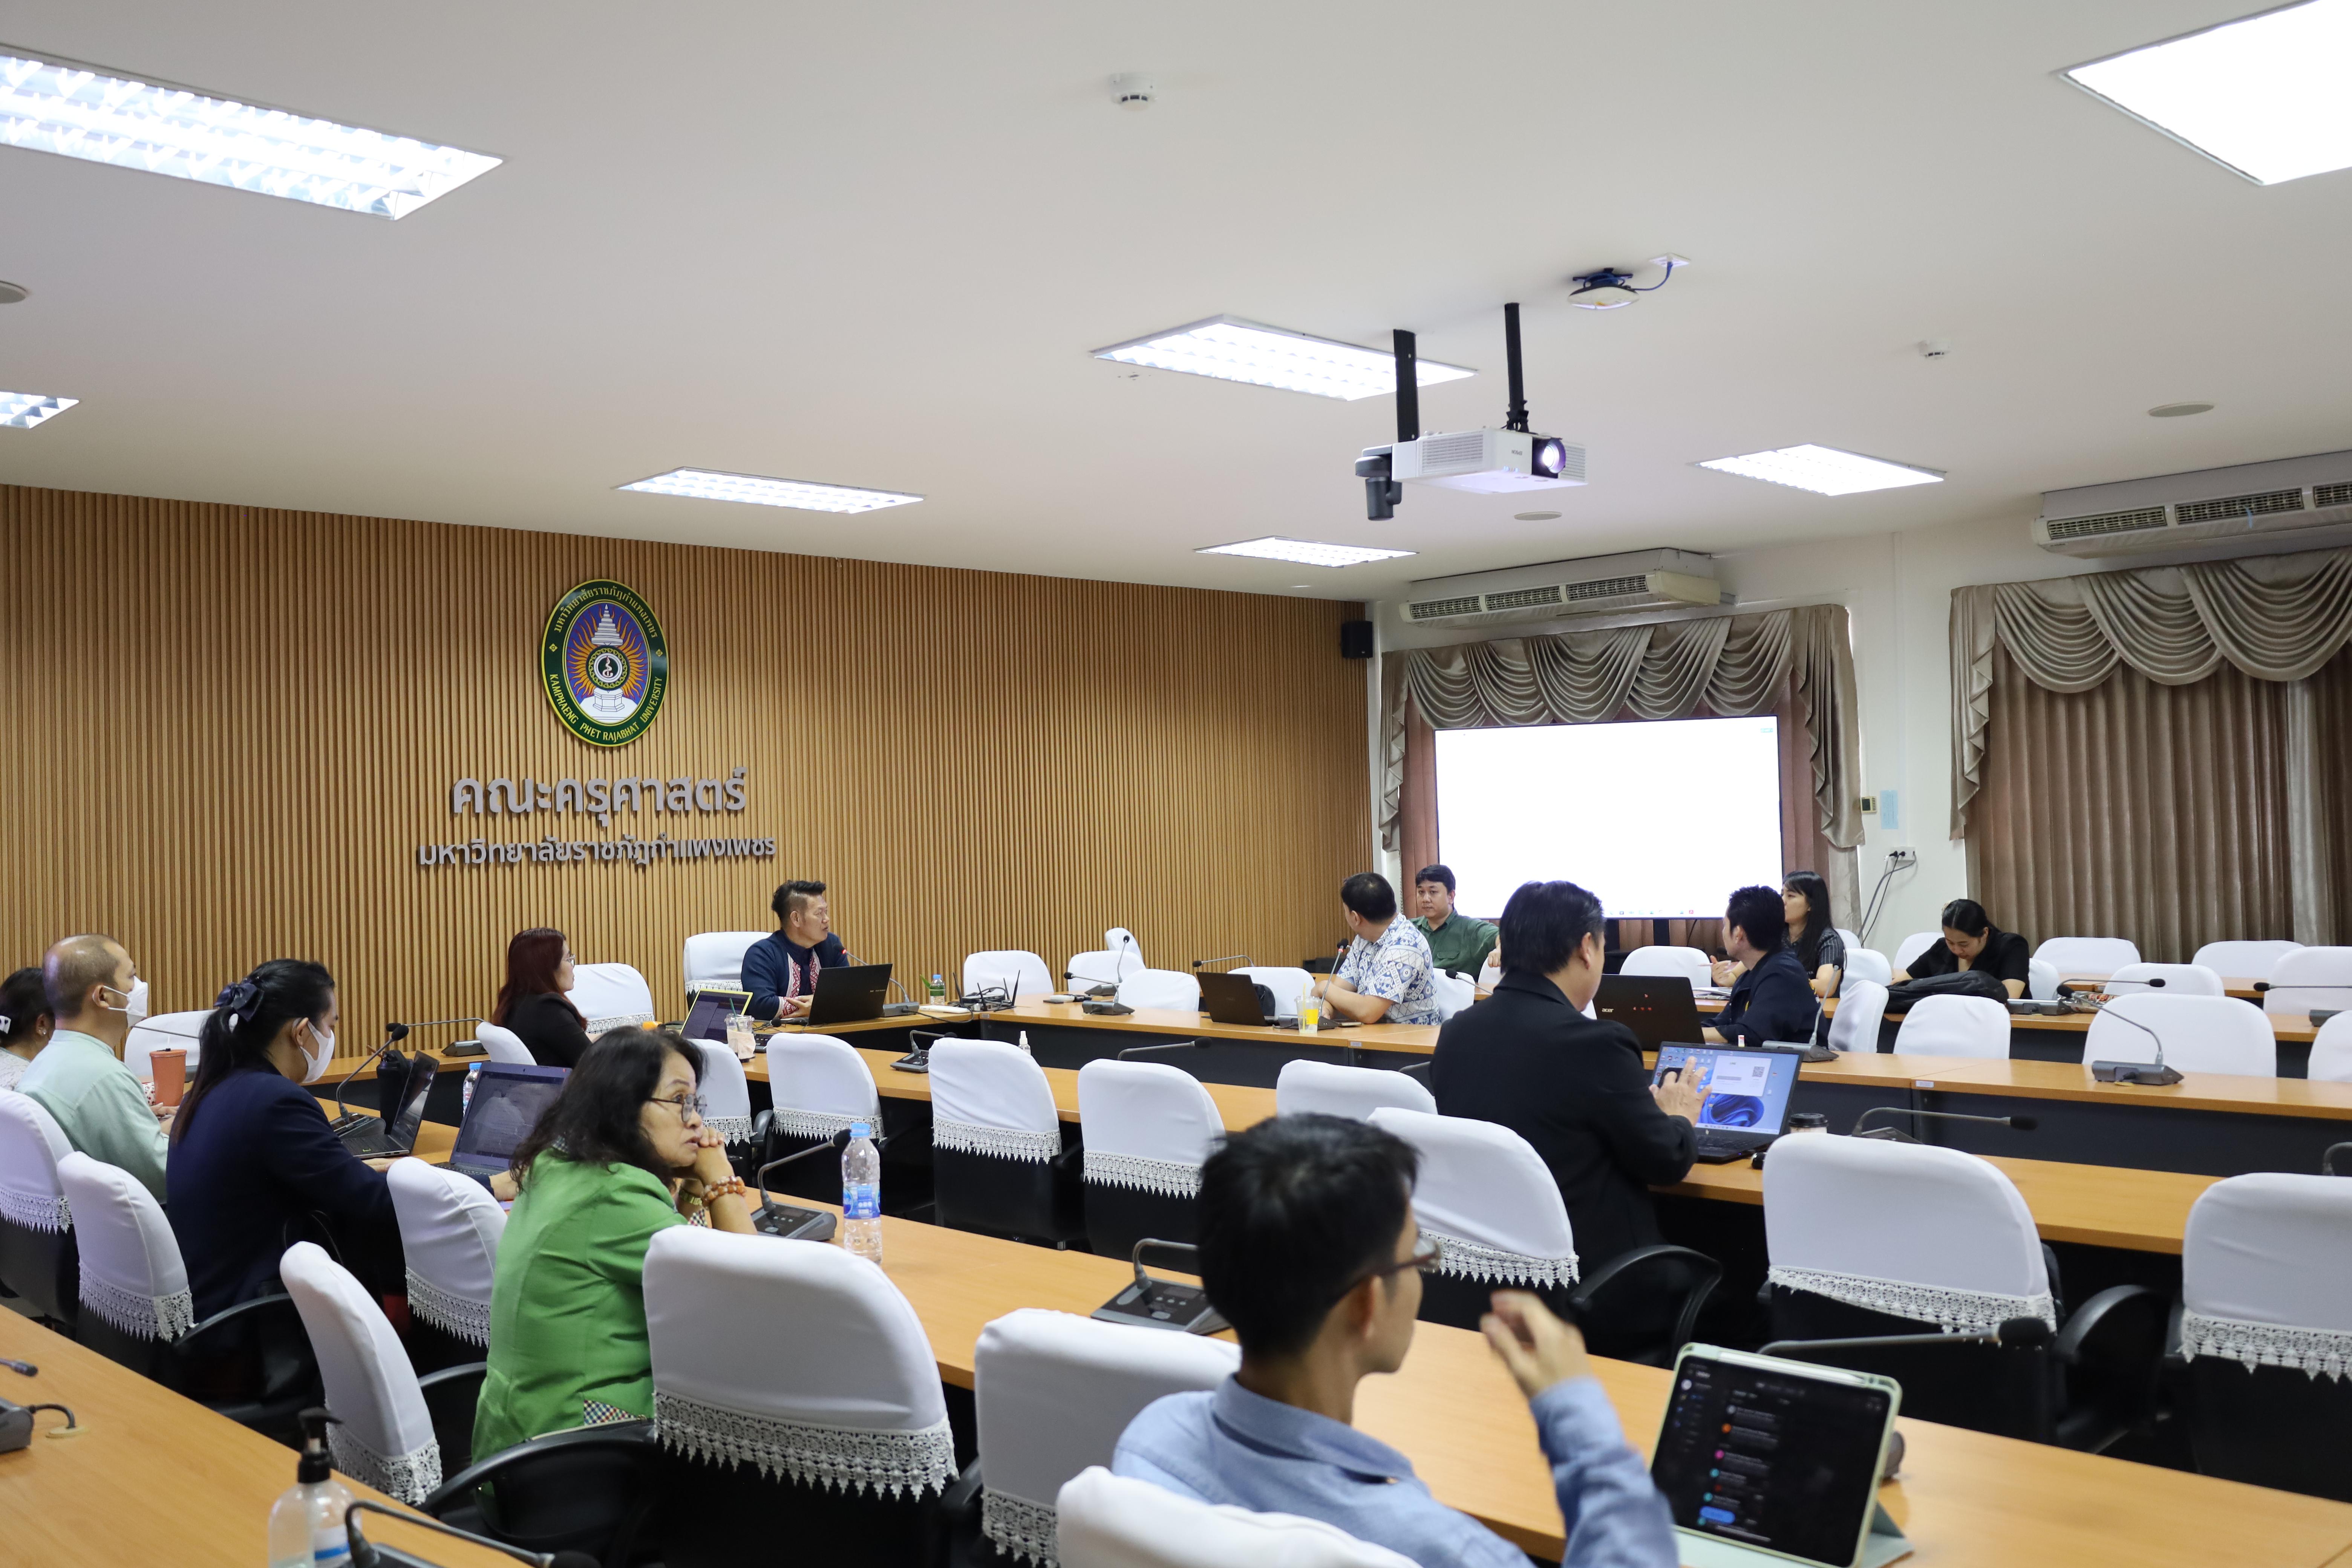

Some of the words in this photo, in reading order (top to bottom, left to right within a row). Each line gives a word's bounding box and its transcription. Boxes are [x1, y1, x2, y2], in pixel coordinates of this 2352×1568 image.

[550, 674, 579, 724] KAMPHAENG
[579, 723, 601, 739] PHET
[603, 722, 640, 743] RAJABHAT
[639, 677, 663, 723] UNIVERSITY
[453, 767, 747, 827] คณะครุศาสตร์
